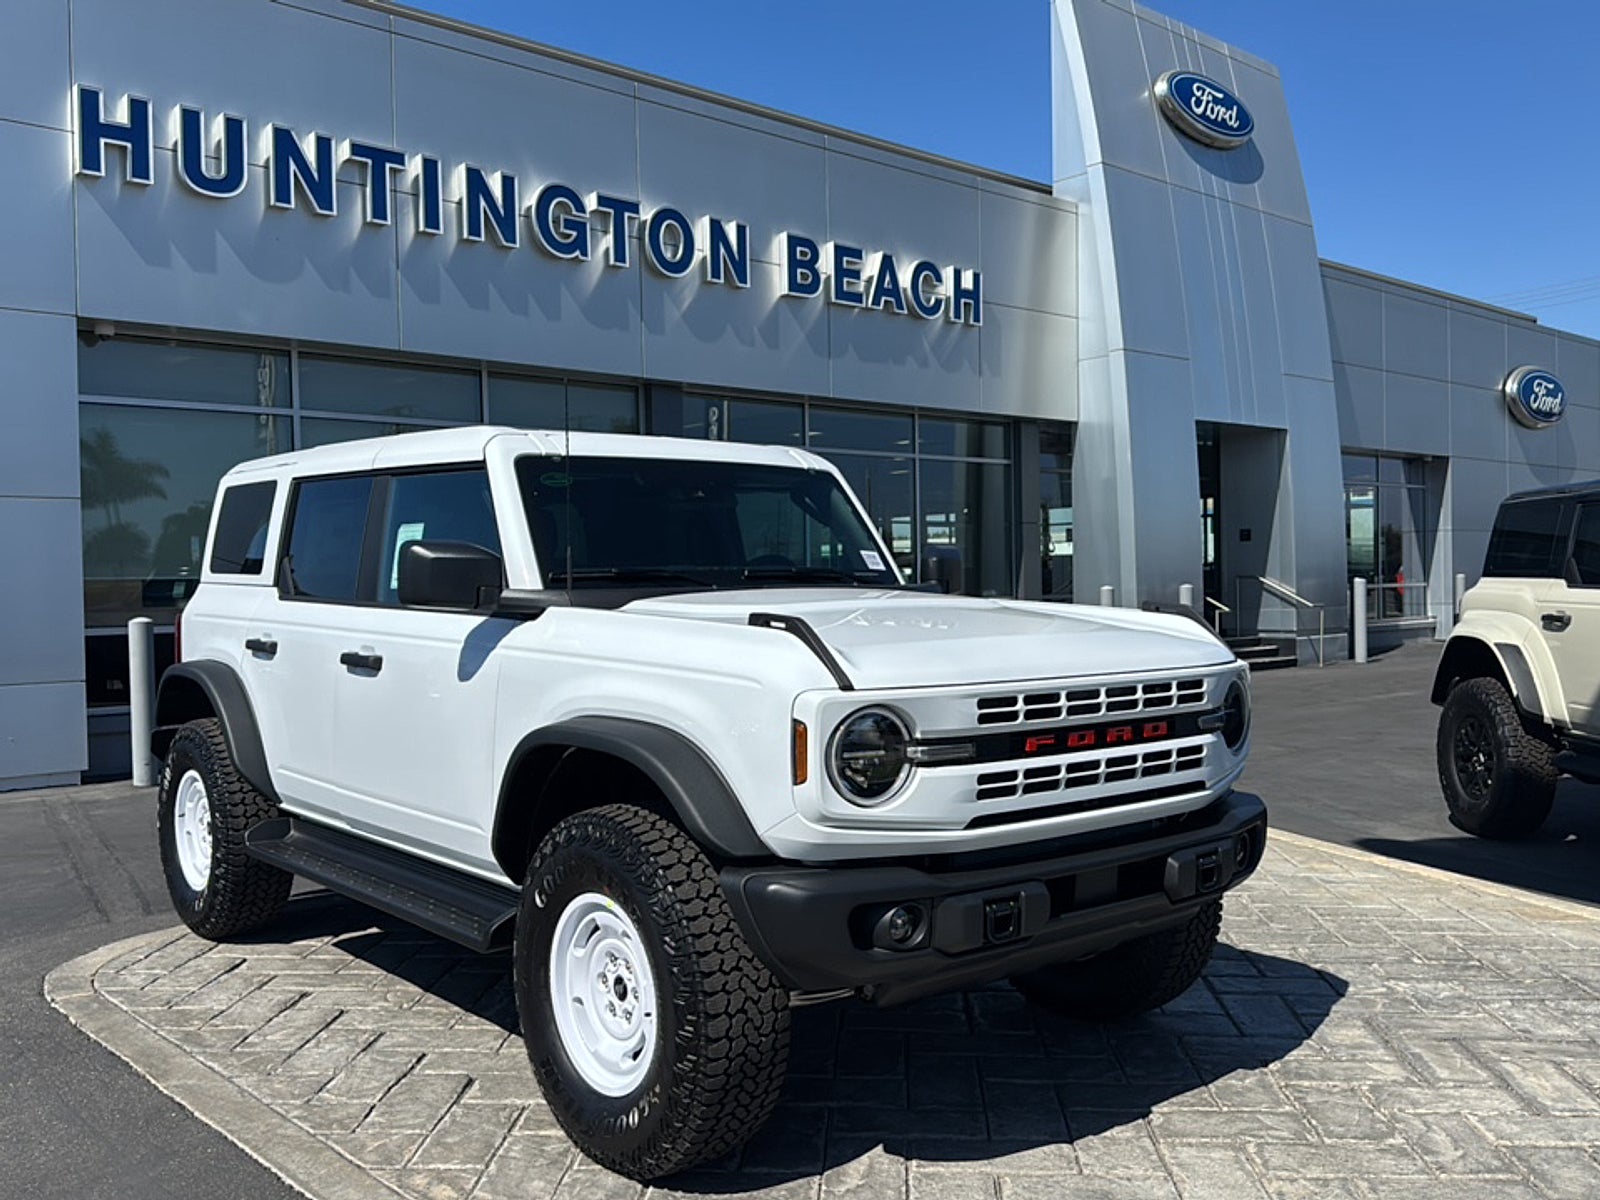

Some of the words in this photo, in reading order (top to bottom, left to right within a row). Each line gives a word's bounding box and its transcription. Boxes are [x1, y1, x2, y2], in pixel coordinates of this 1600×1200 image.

[1190, 82, 1240, 128] Ford
[75, 84, 751, 288] HUNTINGTON
[780, 231, 983, 327] BEACH
[1531, 379, 1563, 413] Ford
[1024, 721, 1169, 753] FORD
